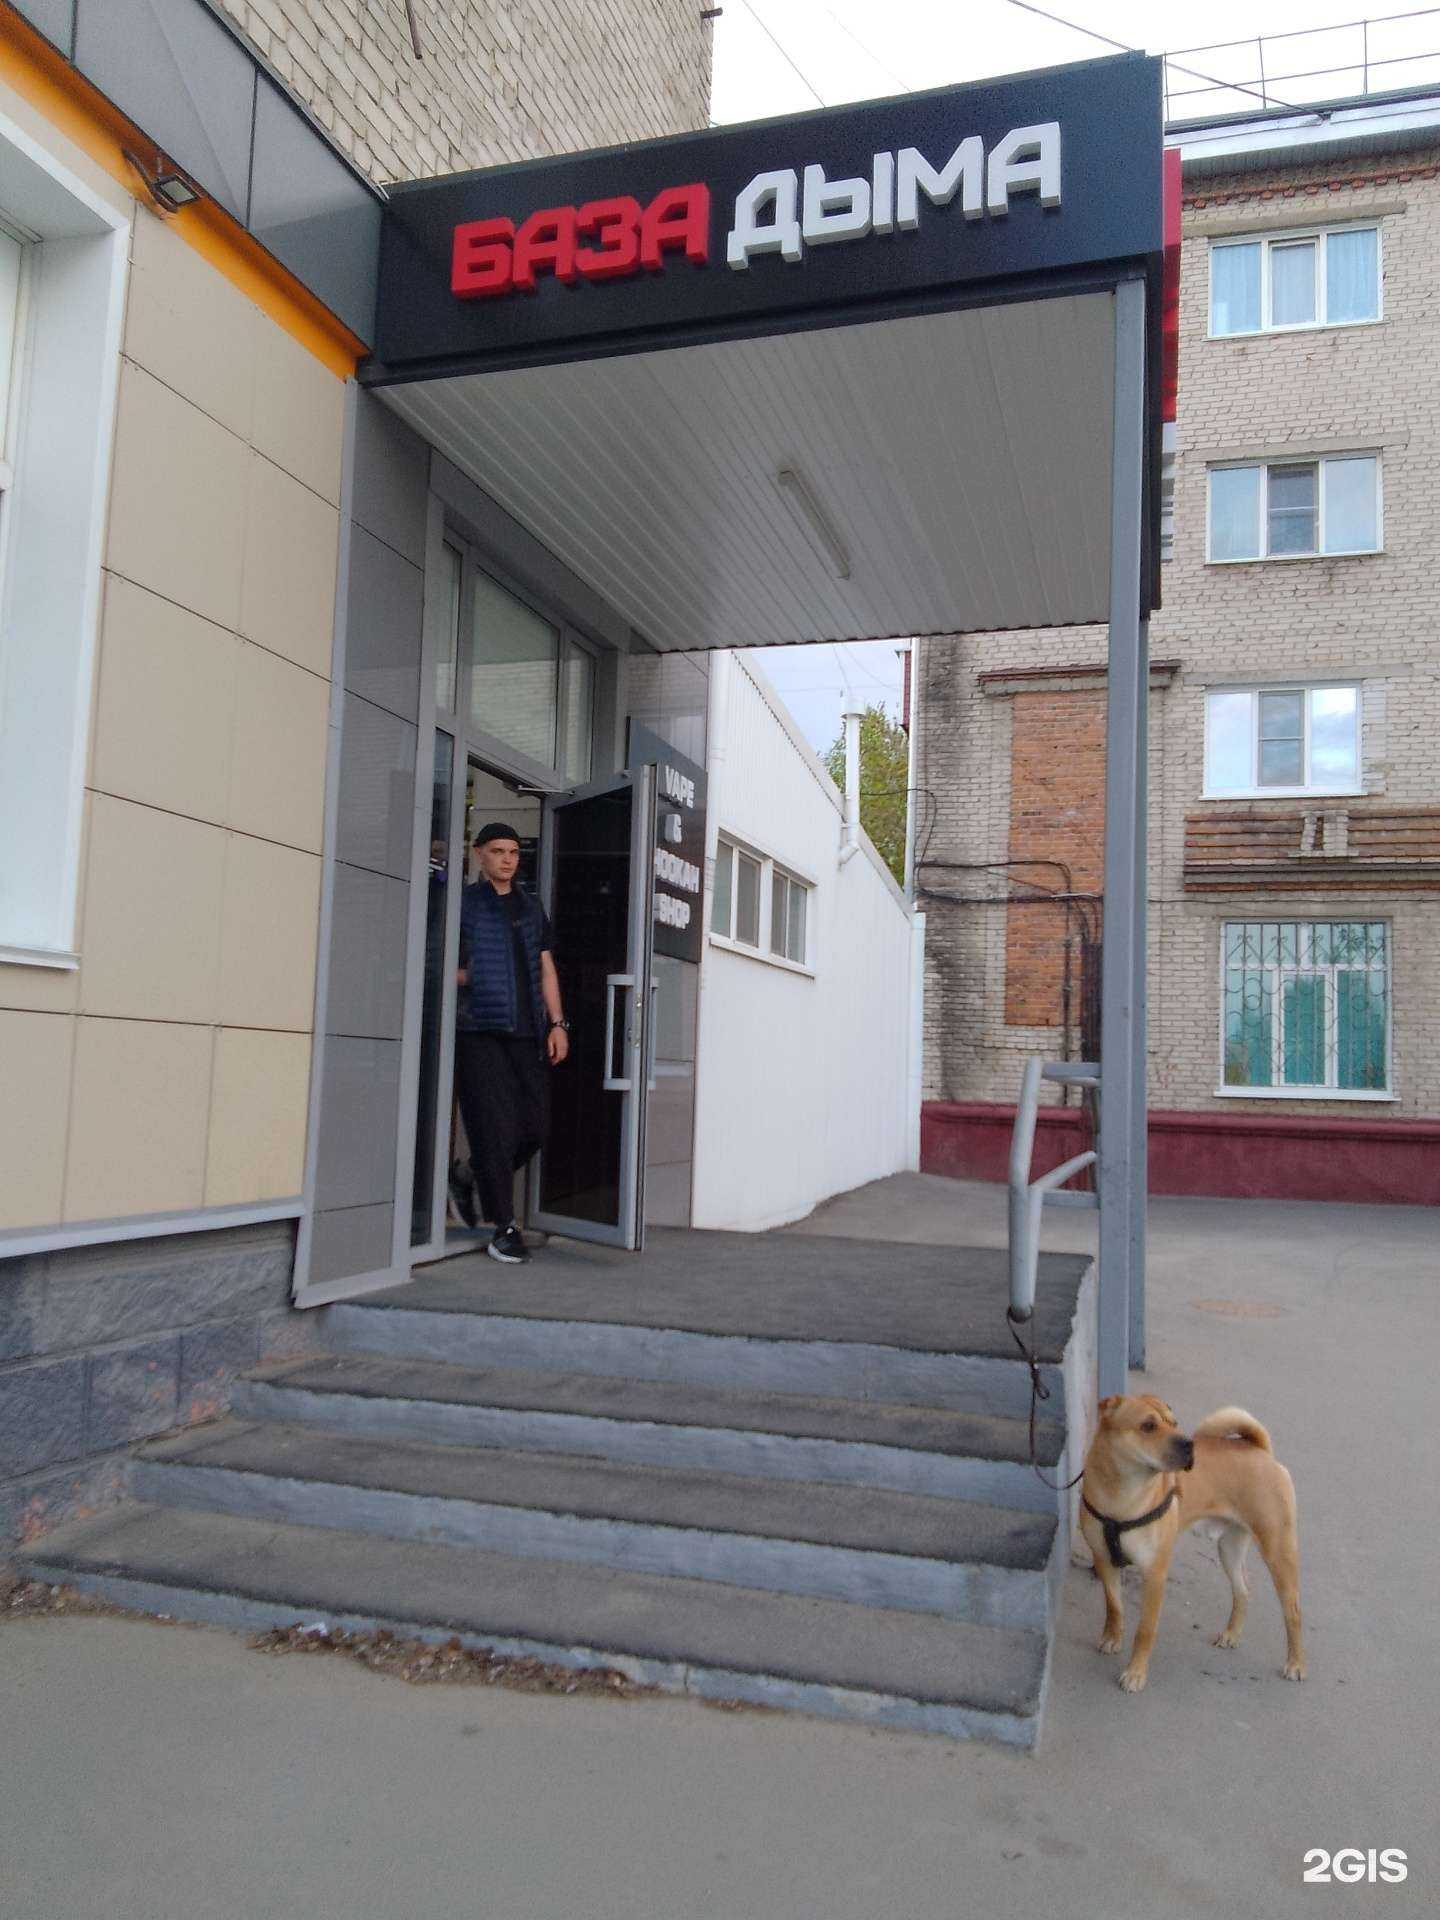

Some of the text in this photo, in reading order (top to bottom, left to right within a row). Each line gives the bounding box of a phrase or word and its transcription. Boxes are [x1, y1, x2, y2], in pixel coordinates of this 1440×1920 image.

[451, 122, 1063, 298] БАЗА ДЫМА
[665, 765, 694, 808] VAPE
